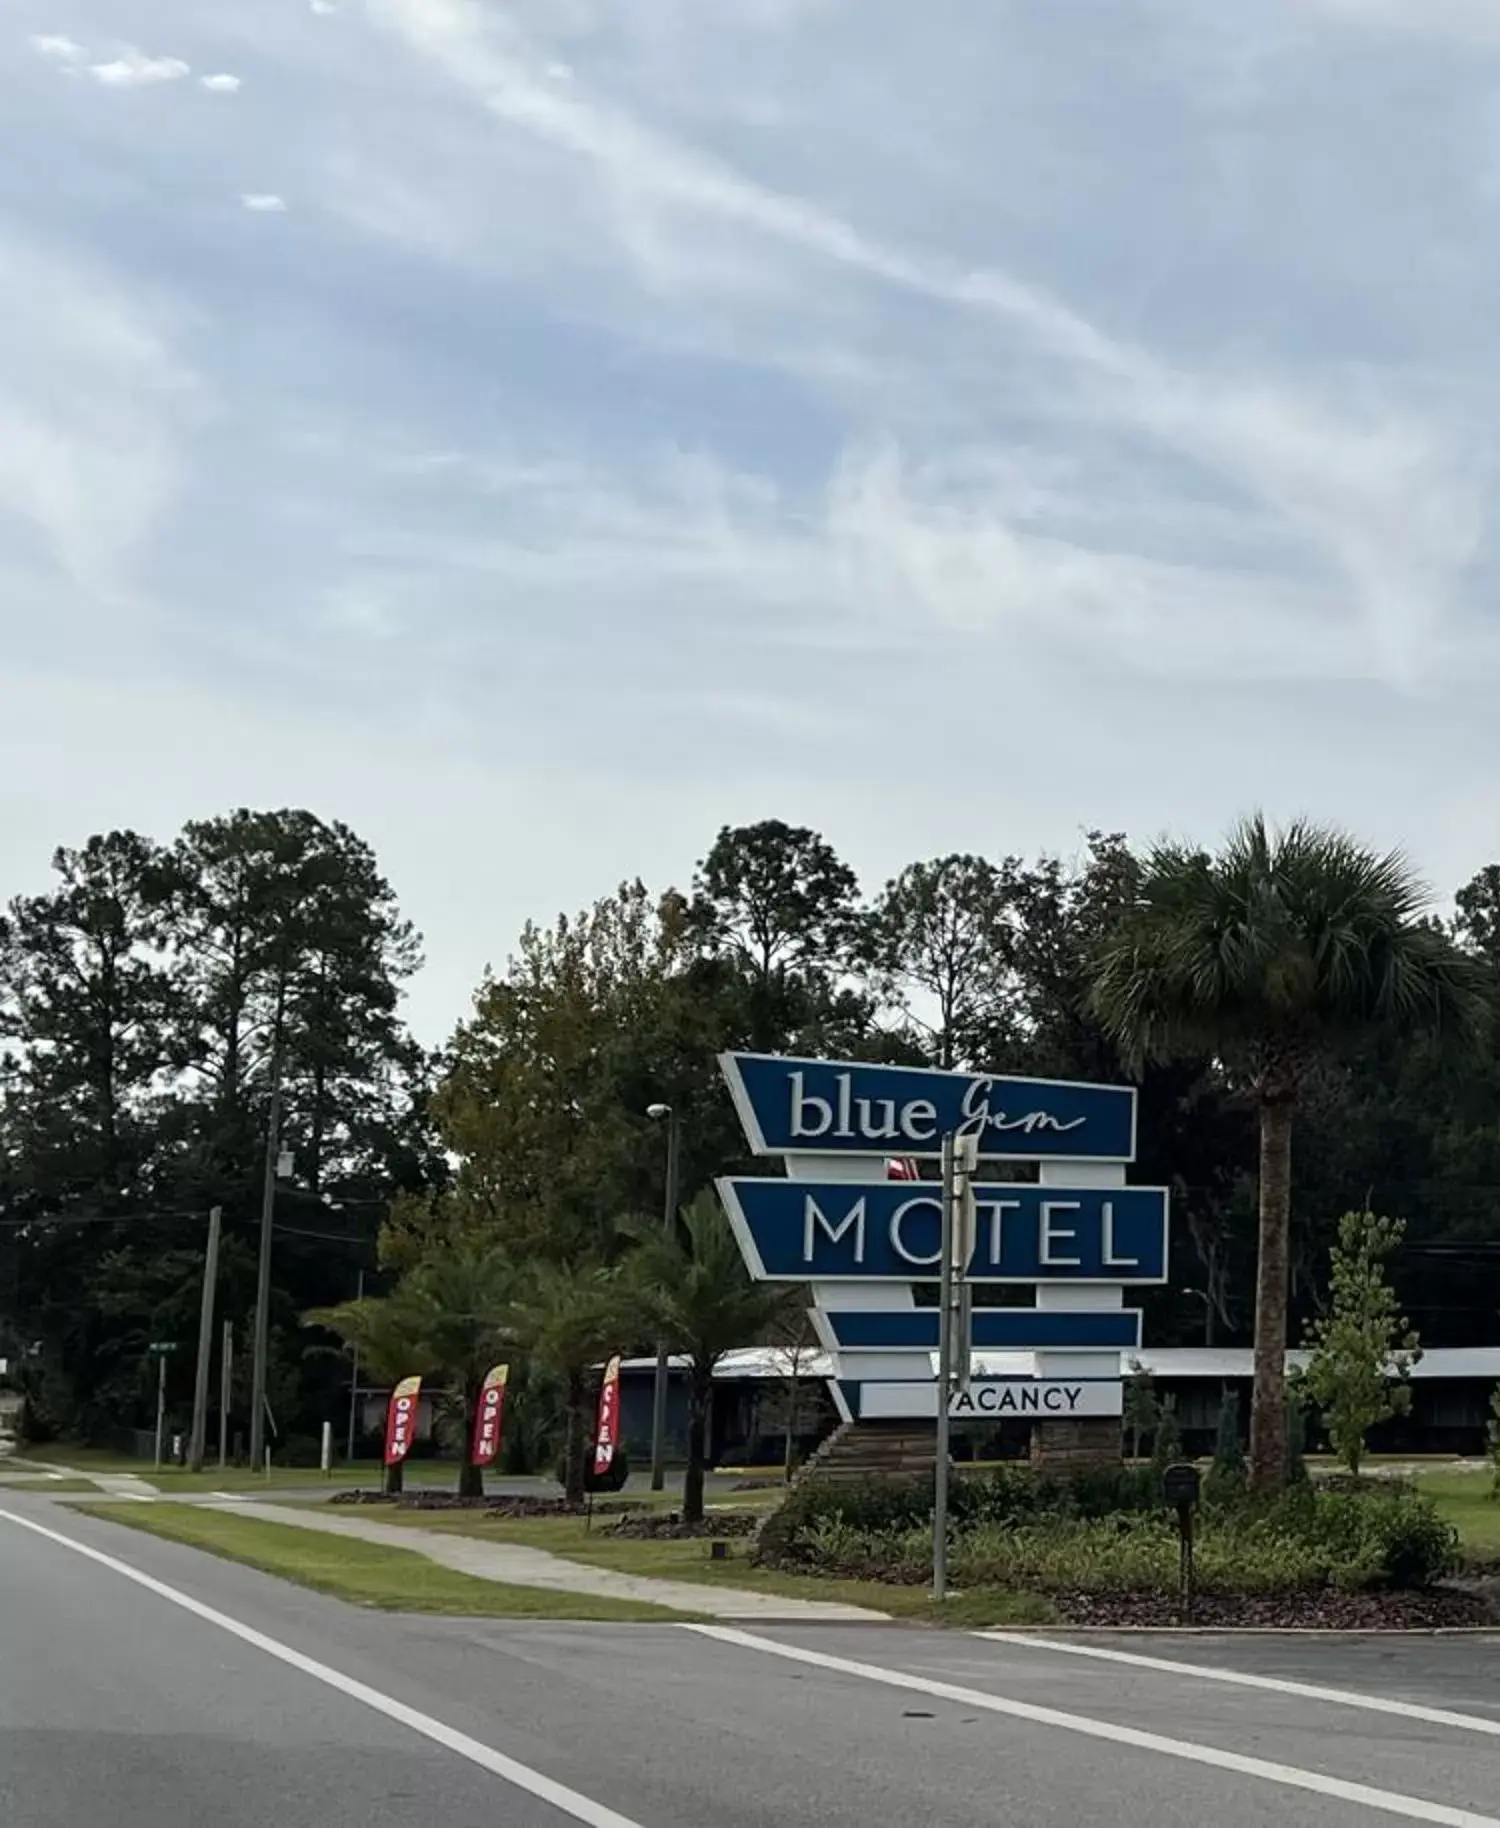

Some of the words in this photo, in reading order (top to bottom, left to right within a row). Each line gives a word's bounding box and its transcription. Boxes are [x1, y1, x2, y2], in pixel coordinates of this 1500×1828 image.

[787, 1071, 937, 1140] blue
[955, 1078, 1088, 1140] Gem
[801, 1194, 1139, 1266] MOTEL
[391, 1397, 411, 1455] OPEN
[478, 1389, 499, 1456] OPEN
[946, 1386, 1082, 1411] ACANCY
